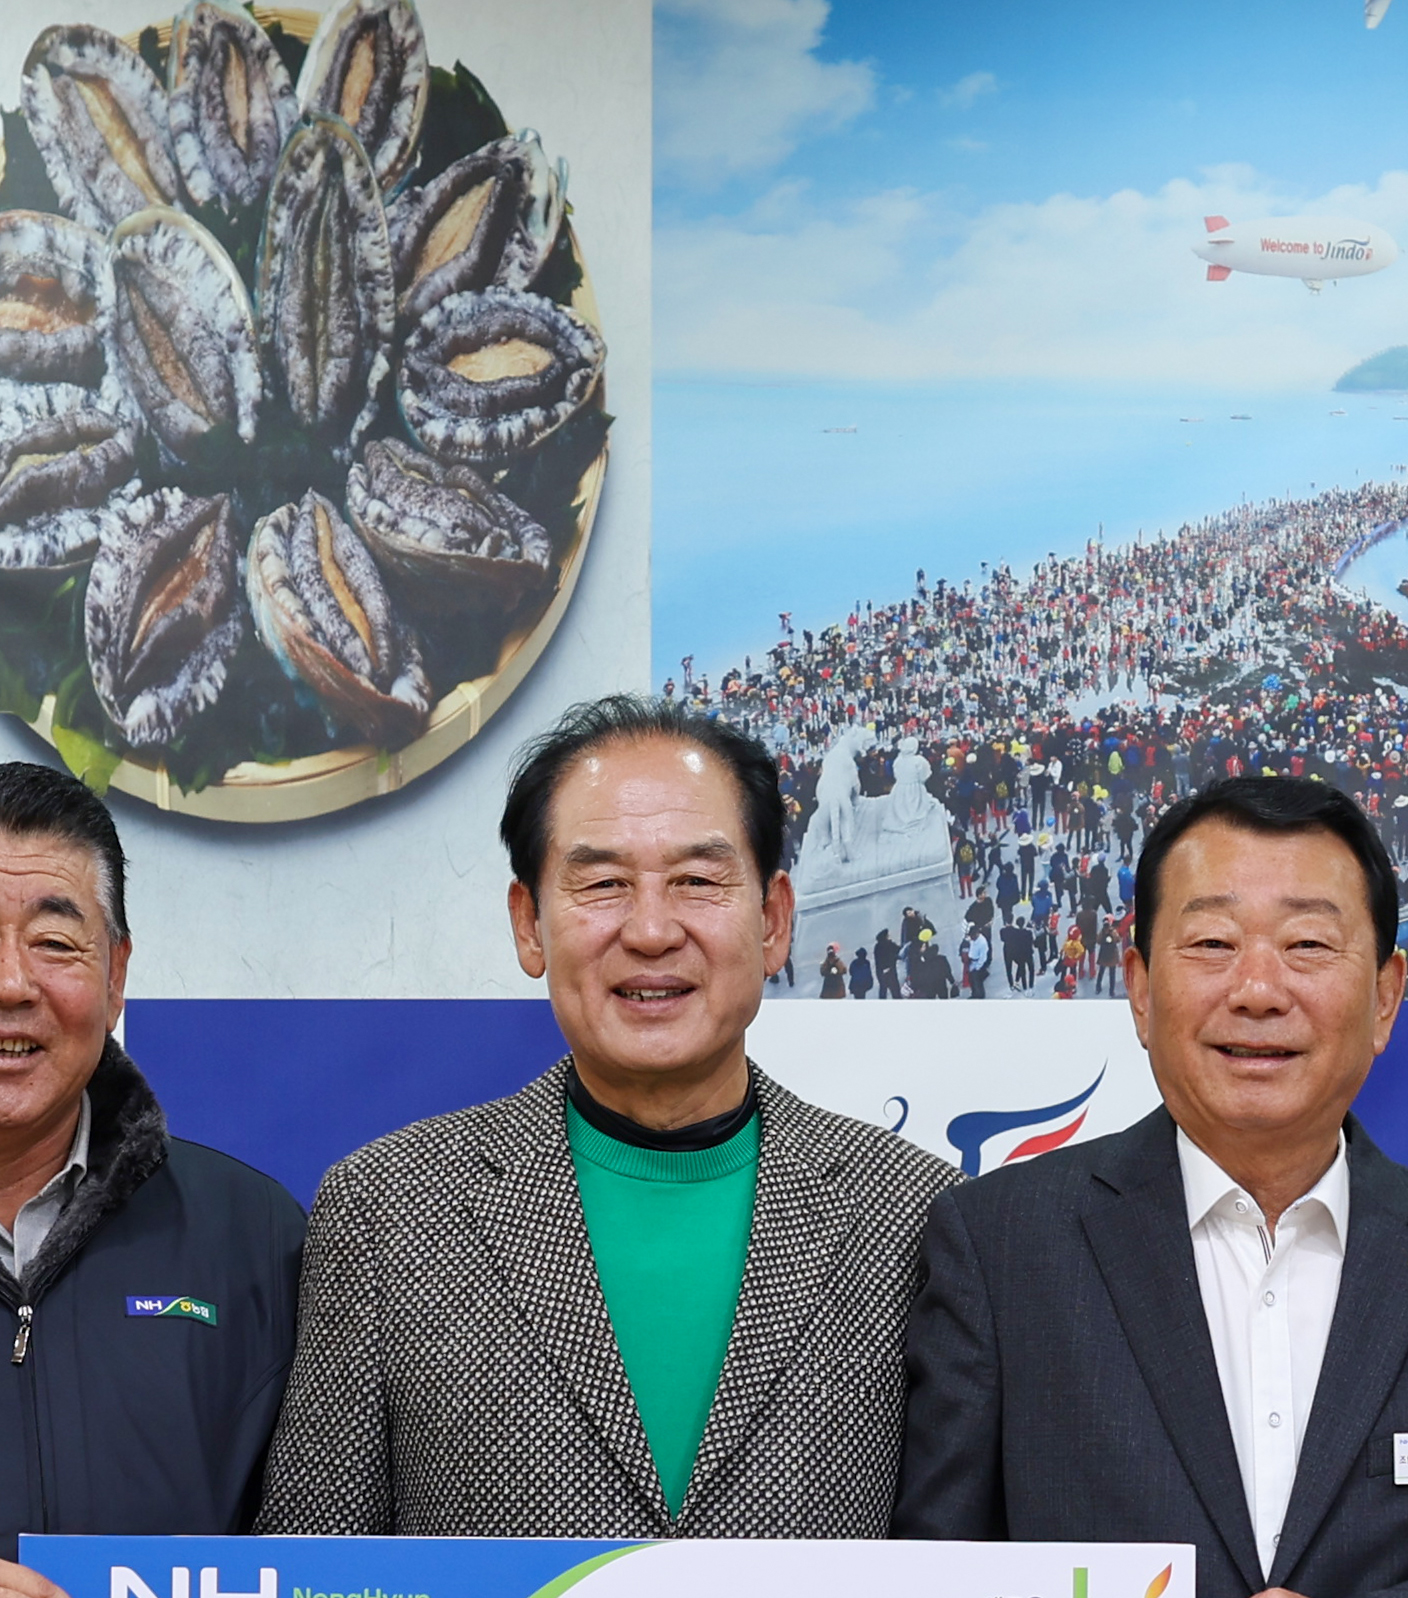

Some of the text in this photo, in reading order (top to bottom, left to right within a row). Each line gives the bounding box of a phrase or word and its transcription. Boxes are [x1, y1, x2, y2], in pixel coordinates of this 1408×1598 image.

[1260, 238, 1310, 255] Welcome
[1313, 241, 1324, 254] to
[135, 1300, 163, 1311] NH
